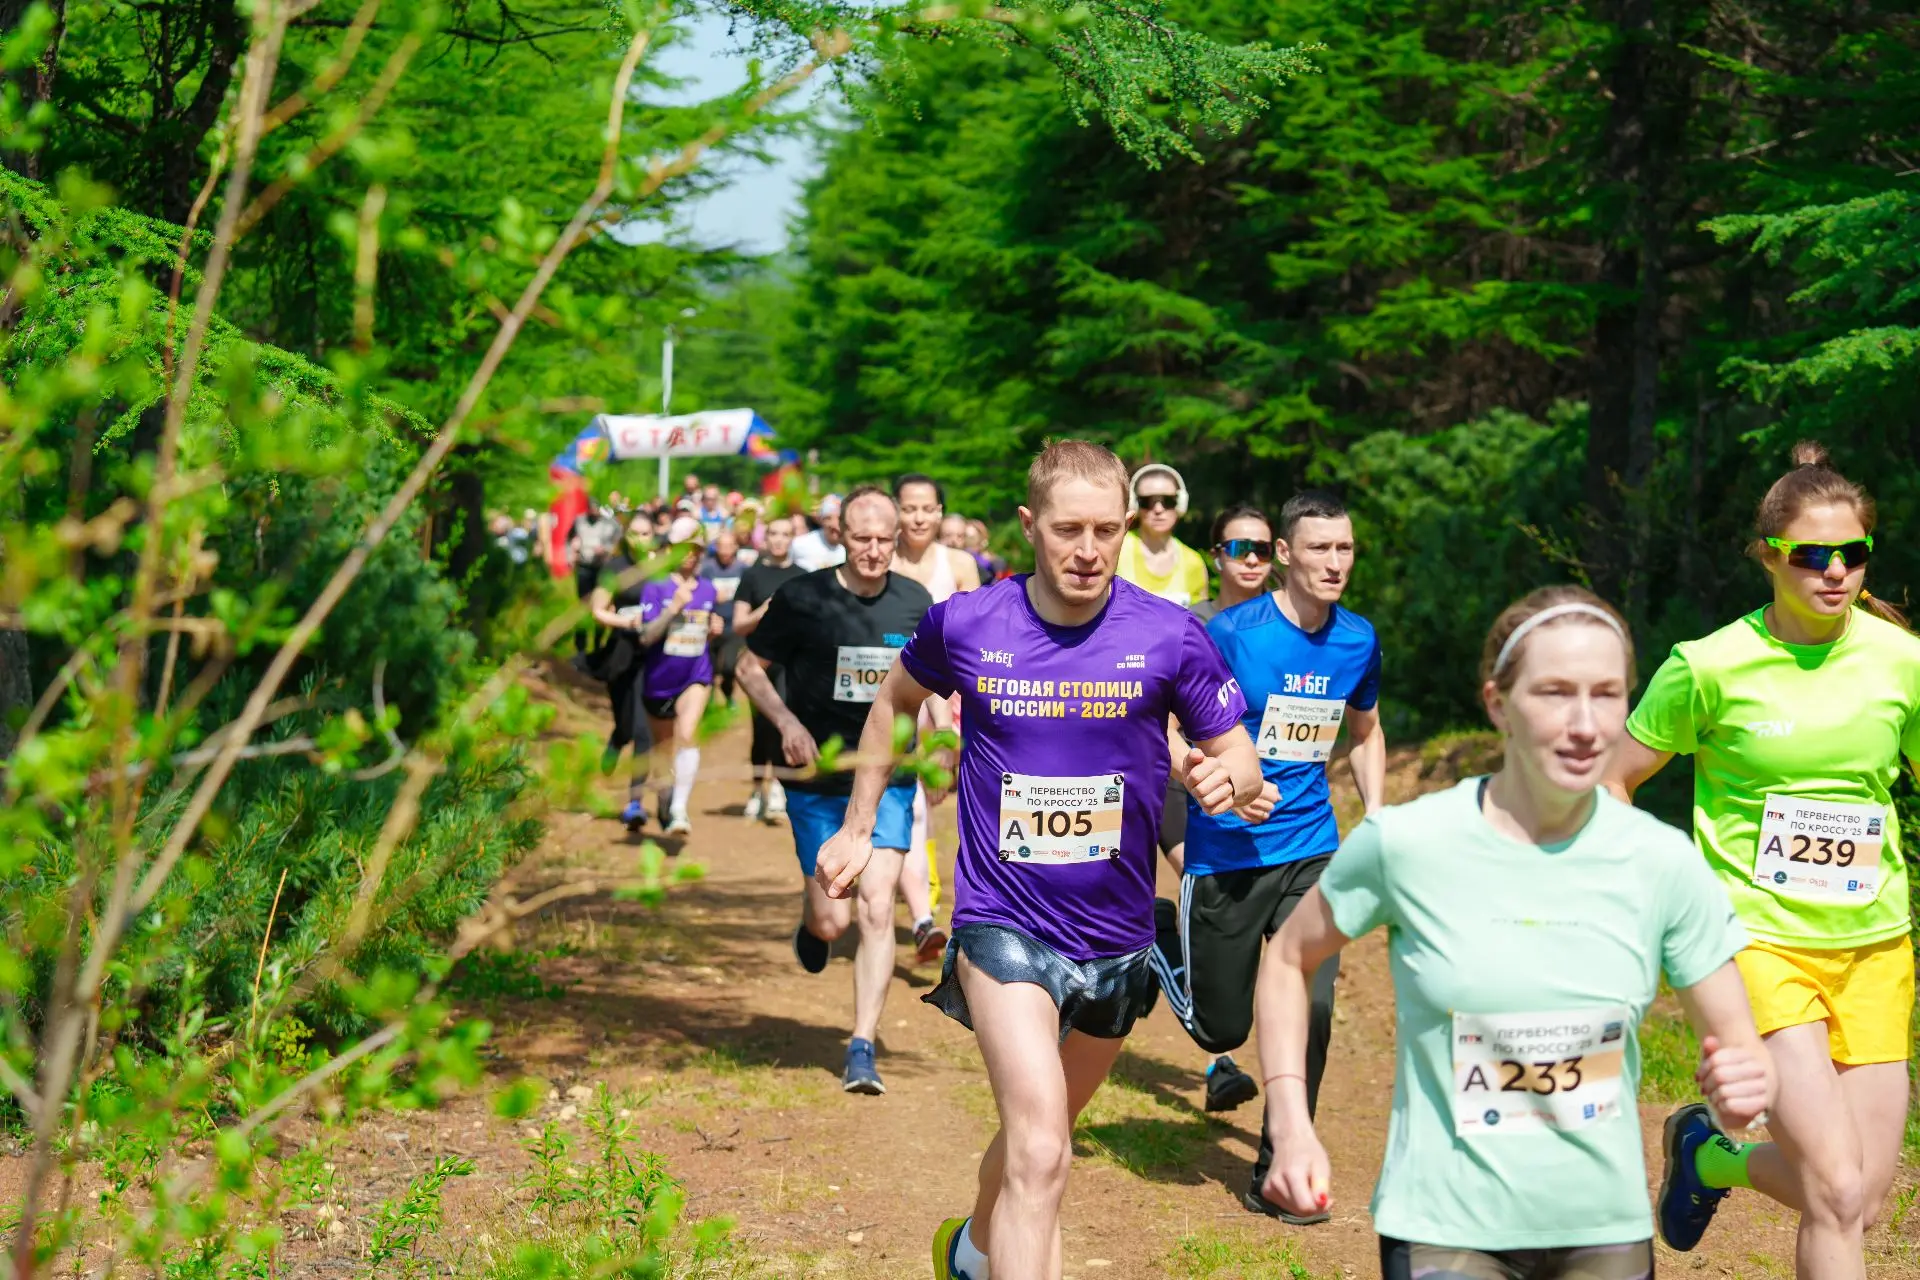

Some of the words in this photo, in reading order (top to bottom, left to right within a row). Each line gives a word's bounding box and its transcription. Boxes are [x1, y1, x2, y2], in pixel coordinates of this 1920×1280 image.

[620, 425, 732, 448] СТАРТ
[856, 669, 890, 685] 107
[977, 676, 1055, 697] БЕГОВАЯ
[1059, 681, 1143, 700] СТОЛИЦА
[990, 698, 1065, 718] РОССИИ
[1081, 701, 1128, 718] 2024
[1286, 722, 1321, 743] 101
[1030, 787, 1096, 796] ПЕРВЕНСТВО
[1027, 798, 1042, 806] ПО
[1044, 799, 1082, 807] КРОССУ
[1085, 798, 1099, 806] '25
[1766, 810, 1785, 820] ПТК
[1795, 809, 1861, 824] ПЕРВЕНСТВО
[1031, 810, 1093, 838] 105
[1790, 821, 1806, 830] ПО
[1808, 824, 1847, 835] КРОССУ
[1850, 827, 1862, 836] '25
[1789, 834, 1856, 868] 239
[1496, 1024, 1591, 1039] ПЕРВЕНСТВО
[1492, 1043, 1514, 1055] ПО
[1518, 1043, 1573, 1055] КРОССУ
[1501, 1055, 1584, 1096] 233
